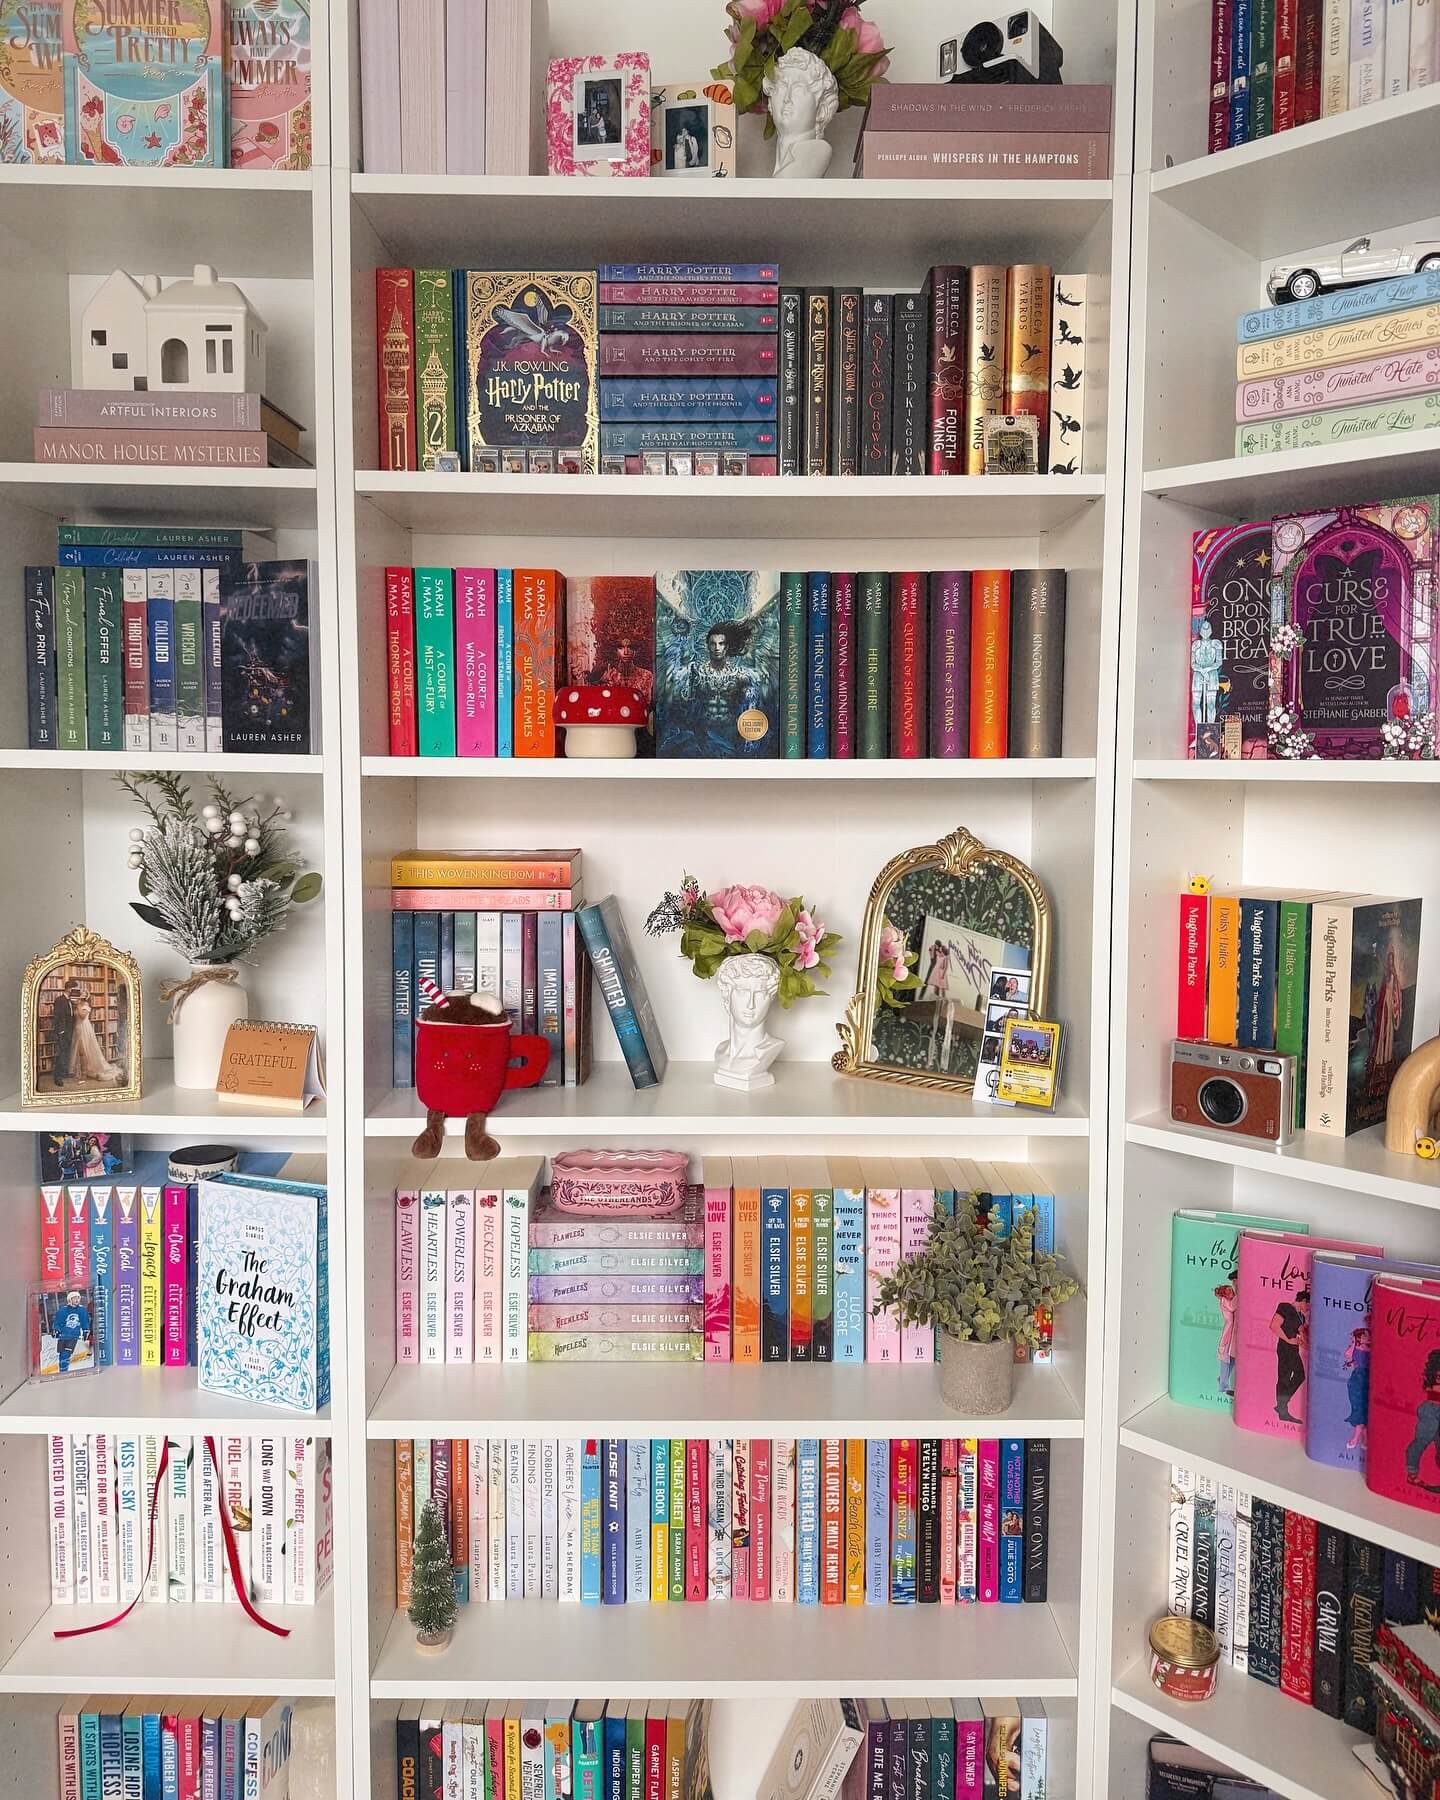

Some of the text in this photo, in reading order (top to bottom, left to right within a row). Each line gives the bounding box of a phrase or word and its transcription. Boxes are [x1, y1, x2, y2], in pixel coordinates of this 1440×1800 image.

[106, 25, 192, 65] PRETTY
[147, 26, 177, 37] TURNED
[1330, 17, 1340, 56] GREED
[250, 48, 269, 57] HAVE
[891, 104, 934, 112] SHADOWS
[1279, 91, 1289, 113] ANA
[933, 152, 1079, 165] WHISPERS IN THE HAMPTONS
[637, 266, 732, 275] HARRY POTTER
[935, 283, 944, 332] YARROS
[950, 279, 960, 336] REBECCA
[514, 361, 569, 375] ROWLING
[1383, 359, 1424, 383] Hate
[485, 373, 581, 408] Harry Potter
[100, 406, 217, 418] ARTFUL INTERIORS
[505, 414, 547, 423] PRISONER
[512, 423, 555, 434] AZKABAN
[44, 443, 261, 463] MANOR HOUSE MYSTERIES
[934, 416, 945, 452] WING
[945, 409, 956, 458] FOURTH
[973, 416, 984, 450] WING
[401, 576, 410, 614] SARAH
[423, 587, 432, 619] MAAS
[1306, 577, 1388, 607] CURSE
[1335, 604, 1357, 616] FOR
[37, 634, 46, 666] PRINT
[66, 627, 75, 668] CONDITIONS
[100, 627, 109, 664] OFFER
[129, 617, 142, 669] THROTTLED
[155, 620, 169, 662] COLLIDED
[182, 622, 195, 665] WRECKED
[1308, 614, 1385, 645] TRUE
[390, 630, 401, 725] THORNS ROSES
[424, 645, 435, 714] MIST FURY
[466, 642, 475, 717] WINGS RUIN
[814, 632, 824, 728] THRONE GLASS
[838, 624, 848, 735] CROWN MIDNIGHT
[867, 648, 878, 711] HEIR FIRE
[903, 623, 914, 737] QUEEN SHADOWS
[984, 632, 995, 724] TOWER DAWN
[1031, 634, 1042, 724] KINGDOM ASH
[1307, 646, 1387, 673] LOVE
[437, 663, 446, 699] COURT
[523, 656, 532, 737] SILVER FLAMES
[944, 629, 955, 733] EMPIRE STORMS
[788, 704, 797, 737] BLADE
[1303, 708, 1387, 721] STEPHANIE GARBER
[230, 733, 302, 742] LAUREN ASHER
[410, 868, 535, 880] THIS WOVEN KINGDOM
[1185, 907, 1199, 986] Magnolia Parks
[1250, 909, 1264, 987] Magnolia Parks
[1284, 911, 1297, 976] Daisy Haites
[395, 970, 409, 1016] SHATTER
[592, 948, 627, 1009] SHATTER
[542, 968, 557, 1033] IMAGINE ME
[230, 1053, 296, 1069] GRATEFUL
[708, 1201, 727, 1211] WILD
[835, 1207, 863, 1215] THINGS
[427, 1212, 437, 1282] HEARTLESS
[454, 1209, 465, 1283] POWERLESS
[484, 1214, 494, 1277] RECKLESS
[510, 1215, 520, 1279] HOPELESS
[656, 1232, 687, 1240] SILVER
[770, 1237, 781, 1262] ELSIE
[119, 1247, 134, 1272] Goal
[242, 1251, 268, 1274] The
[401, 1212, 412, 1312] FLAWLESS ELSIE
[169, 1234, 183, 1342] Chase ELLE KENNEDY
[216, 1268, 295, 1308] Graham
[1260, 1276, 1293, 1292] THE
[228, 1301, 283, 1338] Effect
[836, 1291, 848, 1336] SCORE
[849, 1296, 861, 1331] LUCY
[227, 1438, 242, 1465] FUEL
[527, 1444, 536, 1484] FINDING
[544, 1445, 553, 1497] FORBIDDEN
[52, 1435, 65, 1519] ADDICTED YOU
[75, 1450, 87, 1496] RICOCHET
[121, 1442, 136, 1512] KISS SKY
[173, 1458, 186, 1499] THRIVE
[261, 1438, 273, 1516] LONG WAY DOWN
[655, 1463, 665, 1515] RULE BOOK
[673, 1459, 683, 1520] CHEAT SHEET
[922, 1442, 930, 1512] EVELYN HUGO
[294, 1488, 305, 1524] PERFECT
[801, 1459, 815, 1532] BEACH READ
[826, 1473, 840, 1584] LOVERS EMILY HENRY
[1029, 1475, 1044, 1570] DAWN ONYX
[1175, 1521, 1190, 1562] CRUEL
[566, 1551, 574, 1594] SHERIDAN
[1196, 1531, 1210, 1582] WICKED
[1259, 1538, 1271, 1649] DANCE THIEVES
[1290, 1556, 1304, 1660] VOW THIEVES
[1317, 1591, 1342, 1655] CARAVAL
[1351, 1592, 1377, 1671] LEGENDARY
[64, 1736, 76, 1787] ENDS WITH
[85, 1732, 98, 1766] STARTS
[102, 1732, 120, 1796] HOPELESS
[123, 1731, 139, 1772] LOSING
[164, 1731, 176, 1782] NOVEMBER
[246, 1732, 258, 1796] CONFESS
[631, 1748, 641, 1784] JUNIPER
[650, 1744, 660, 1778] GARNET
[874, 1748, 884, 1769] BITE
[671, 1756, 680, 1787] JASPER
[965, 1761, 976, 1786] SWEAR
[998, 1760, 1008, 1797] WINNIPEG
